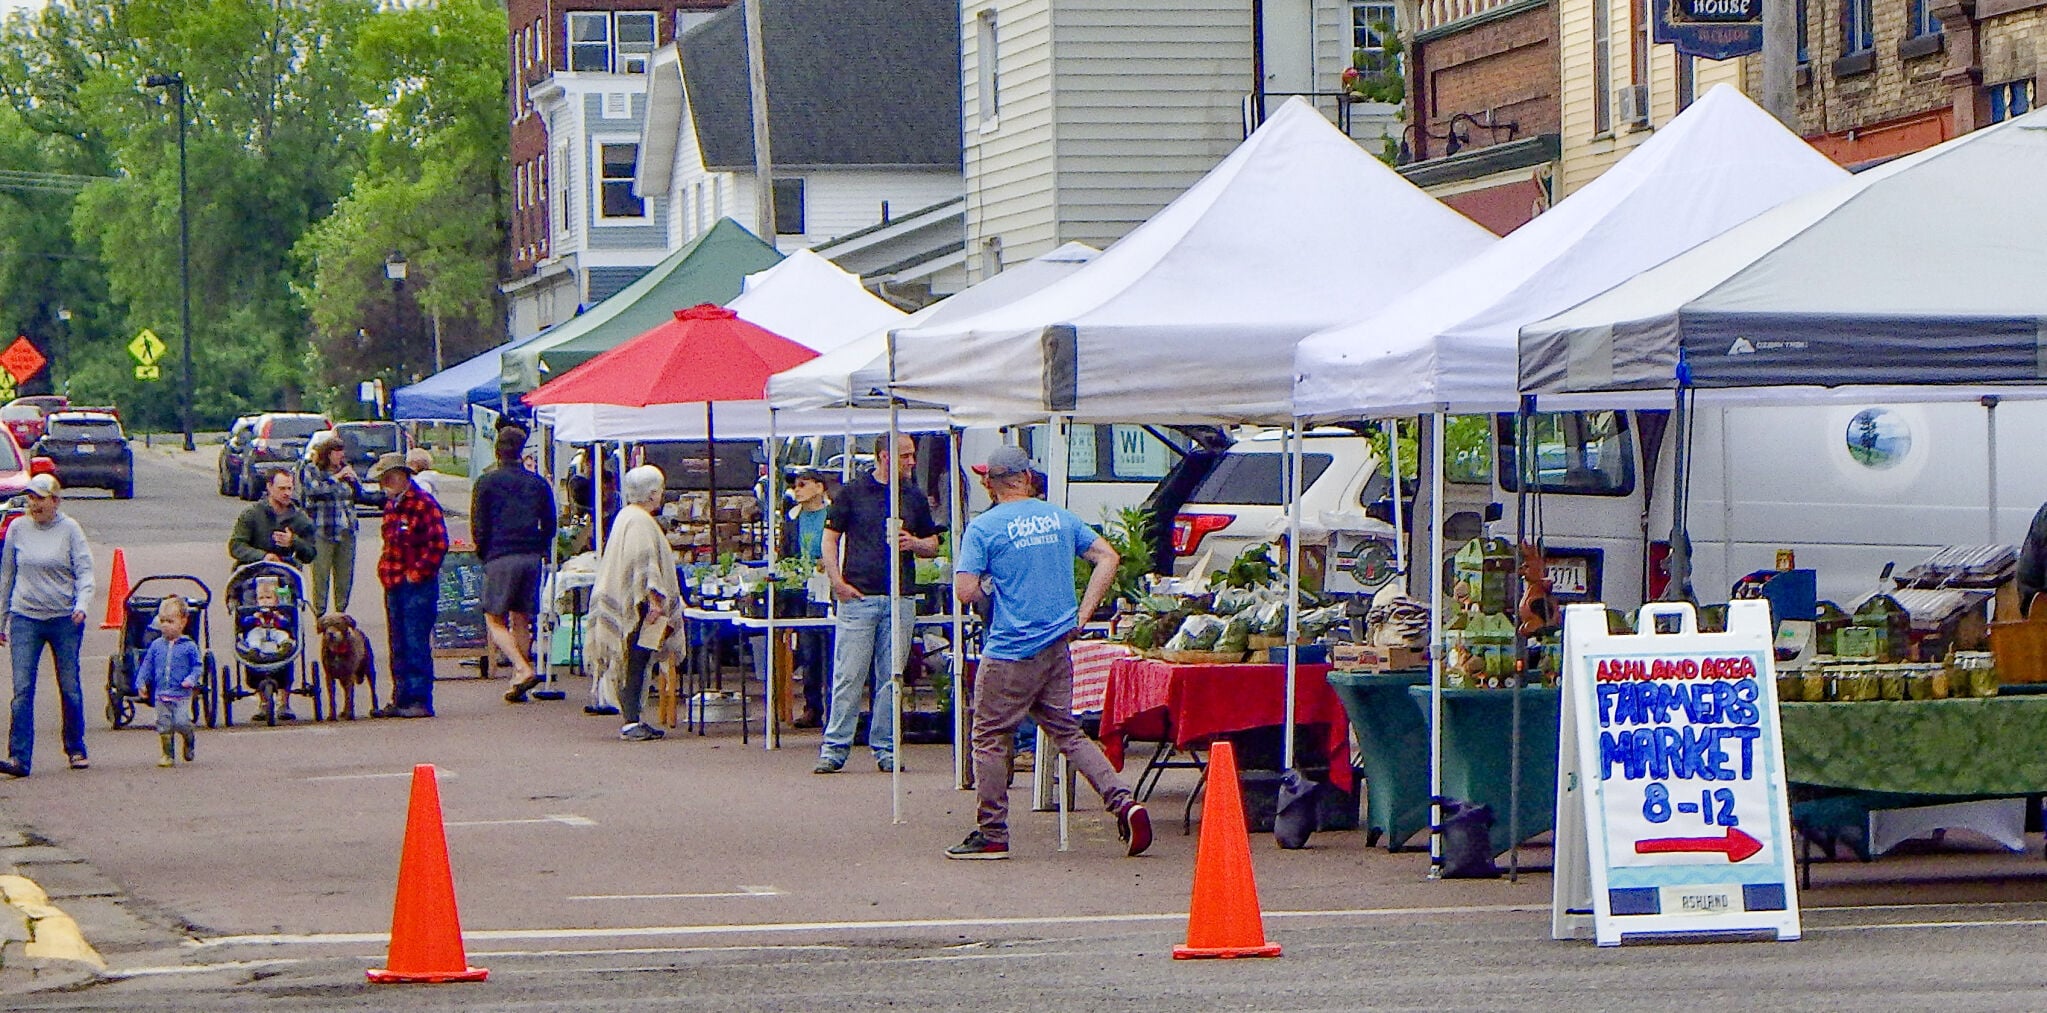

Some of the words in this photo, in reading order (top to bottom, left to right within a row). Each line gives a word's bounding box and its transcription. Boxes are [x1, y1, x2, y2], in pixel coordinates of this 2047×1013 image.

[1121, 431, 1144, 453] WI
[1013, 534, 1059, 549] VOLUNTEER
[1596, 658, 1699, 683] ASHLAND
[1701, 656, 1757, 680] AREA
[1596, 678, 1760, 728] FARMERS
[1599, 725, 1761, 781] MARKET
[1642, 782, 1739, 827] 8-12
[1682, 895, 1729, 910] ASHLAND
